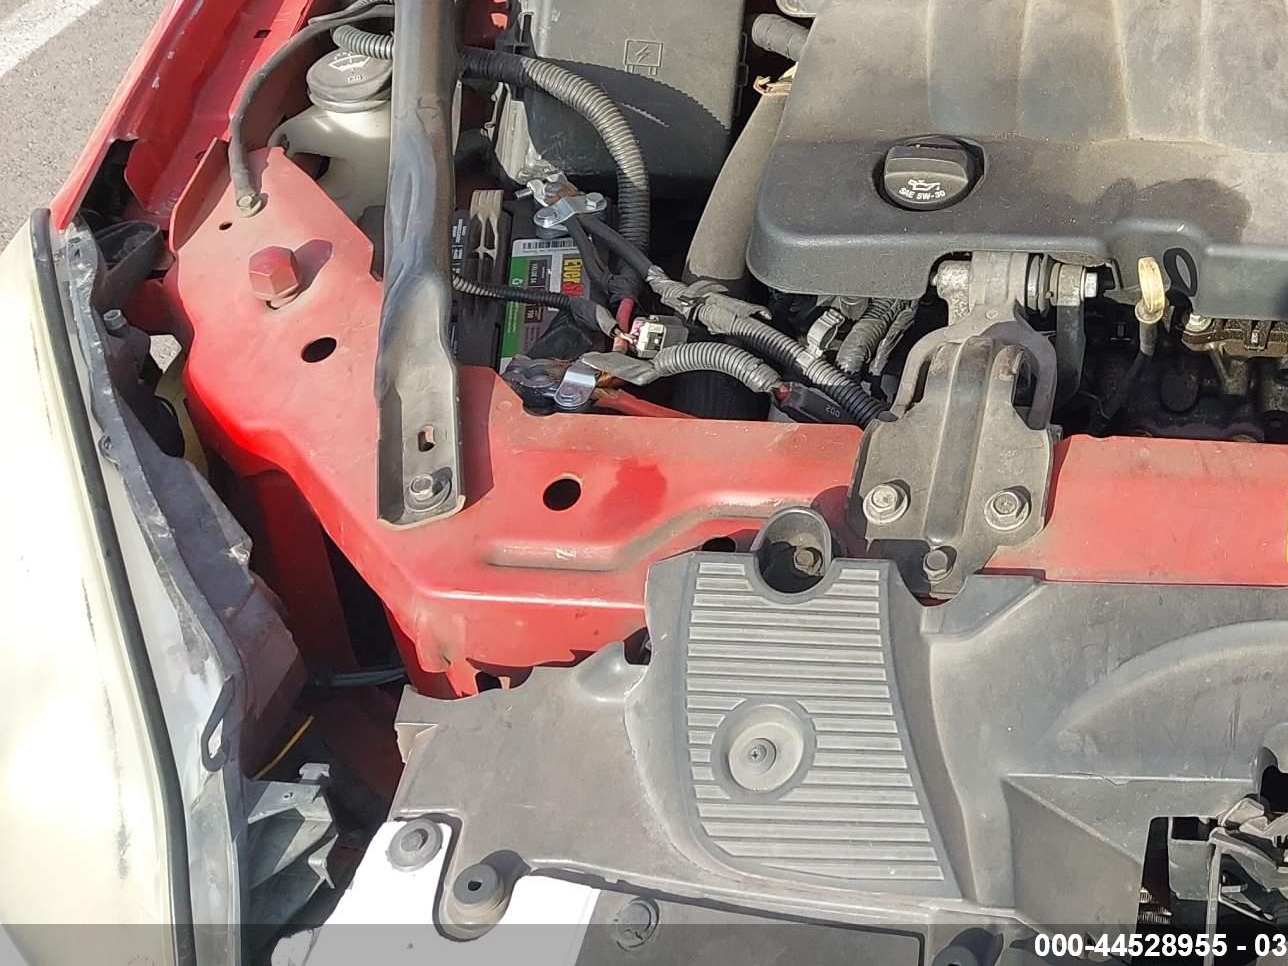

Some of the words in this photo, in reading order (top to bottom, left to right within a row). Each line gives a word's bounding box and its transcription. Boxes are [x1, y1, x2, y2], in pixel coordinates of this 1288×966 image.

[898, 187, 915, 199] SAE
[916, 190, 946, 201] 5W-30
[825, 404, 841, 418] 200
